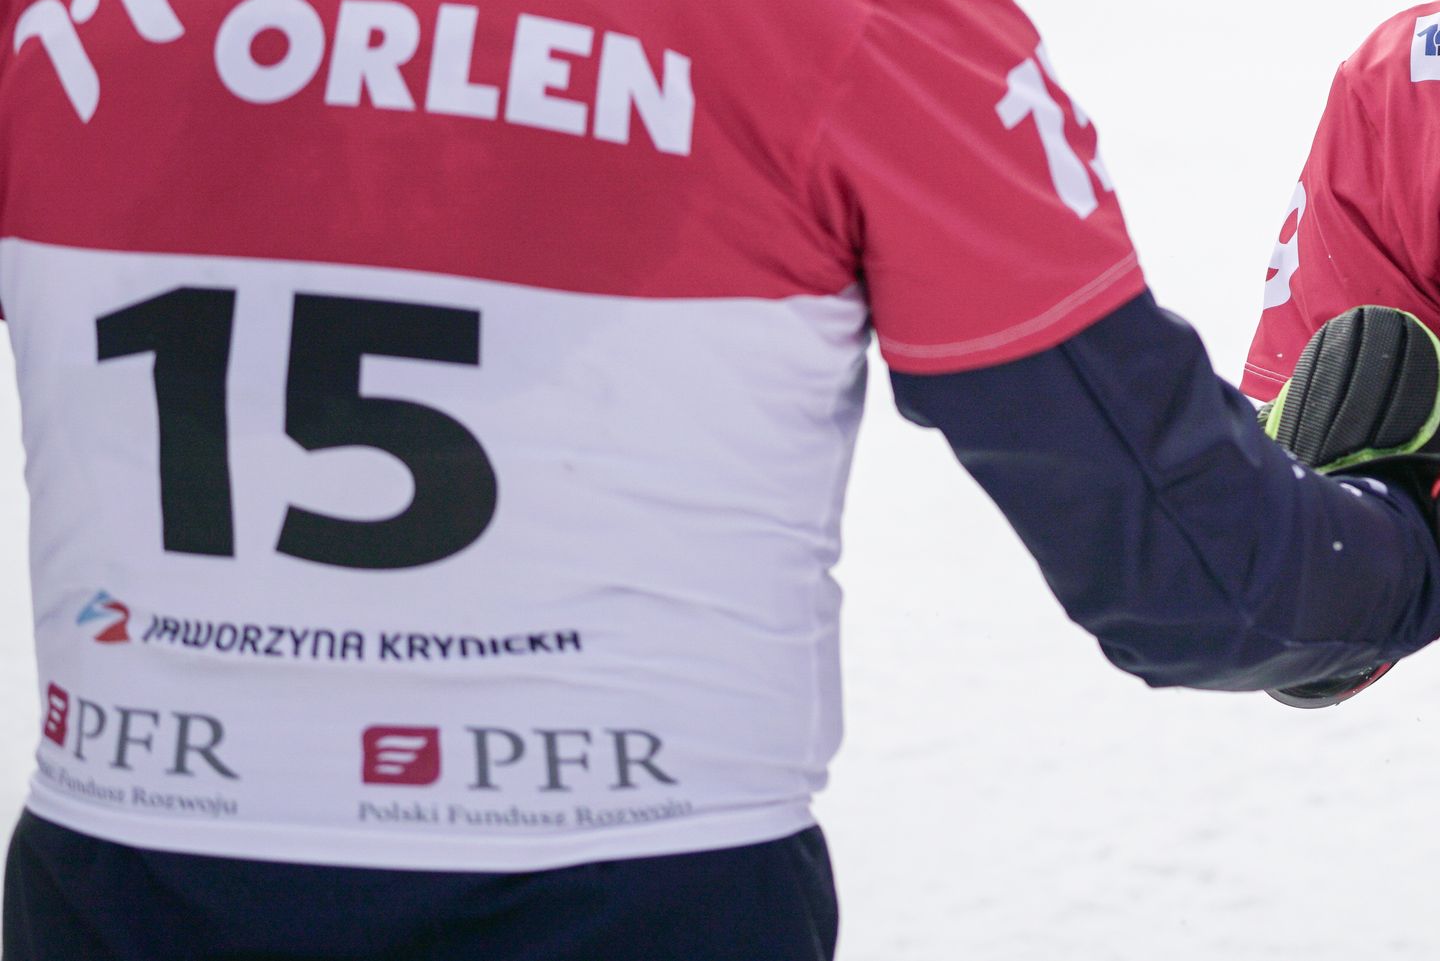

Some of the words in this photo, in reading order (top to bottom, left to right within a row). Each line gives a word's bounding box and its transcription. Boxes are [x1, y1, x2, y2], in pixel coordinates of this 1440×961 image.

[95, 286, 498, 570] 15
[143, 614, 364, 661] JAWORZYNA
[73, 696, 241, 780] PFR
[463, 726, 680, 792] PFR
[357, 801, 440, 825] Polski
[448, 804, 566, 827] Fundusz
